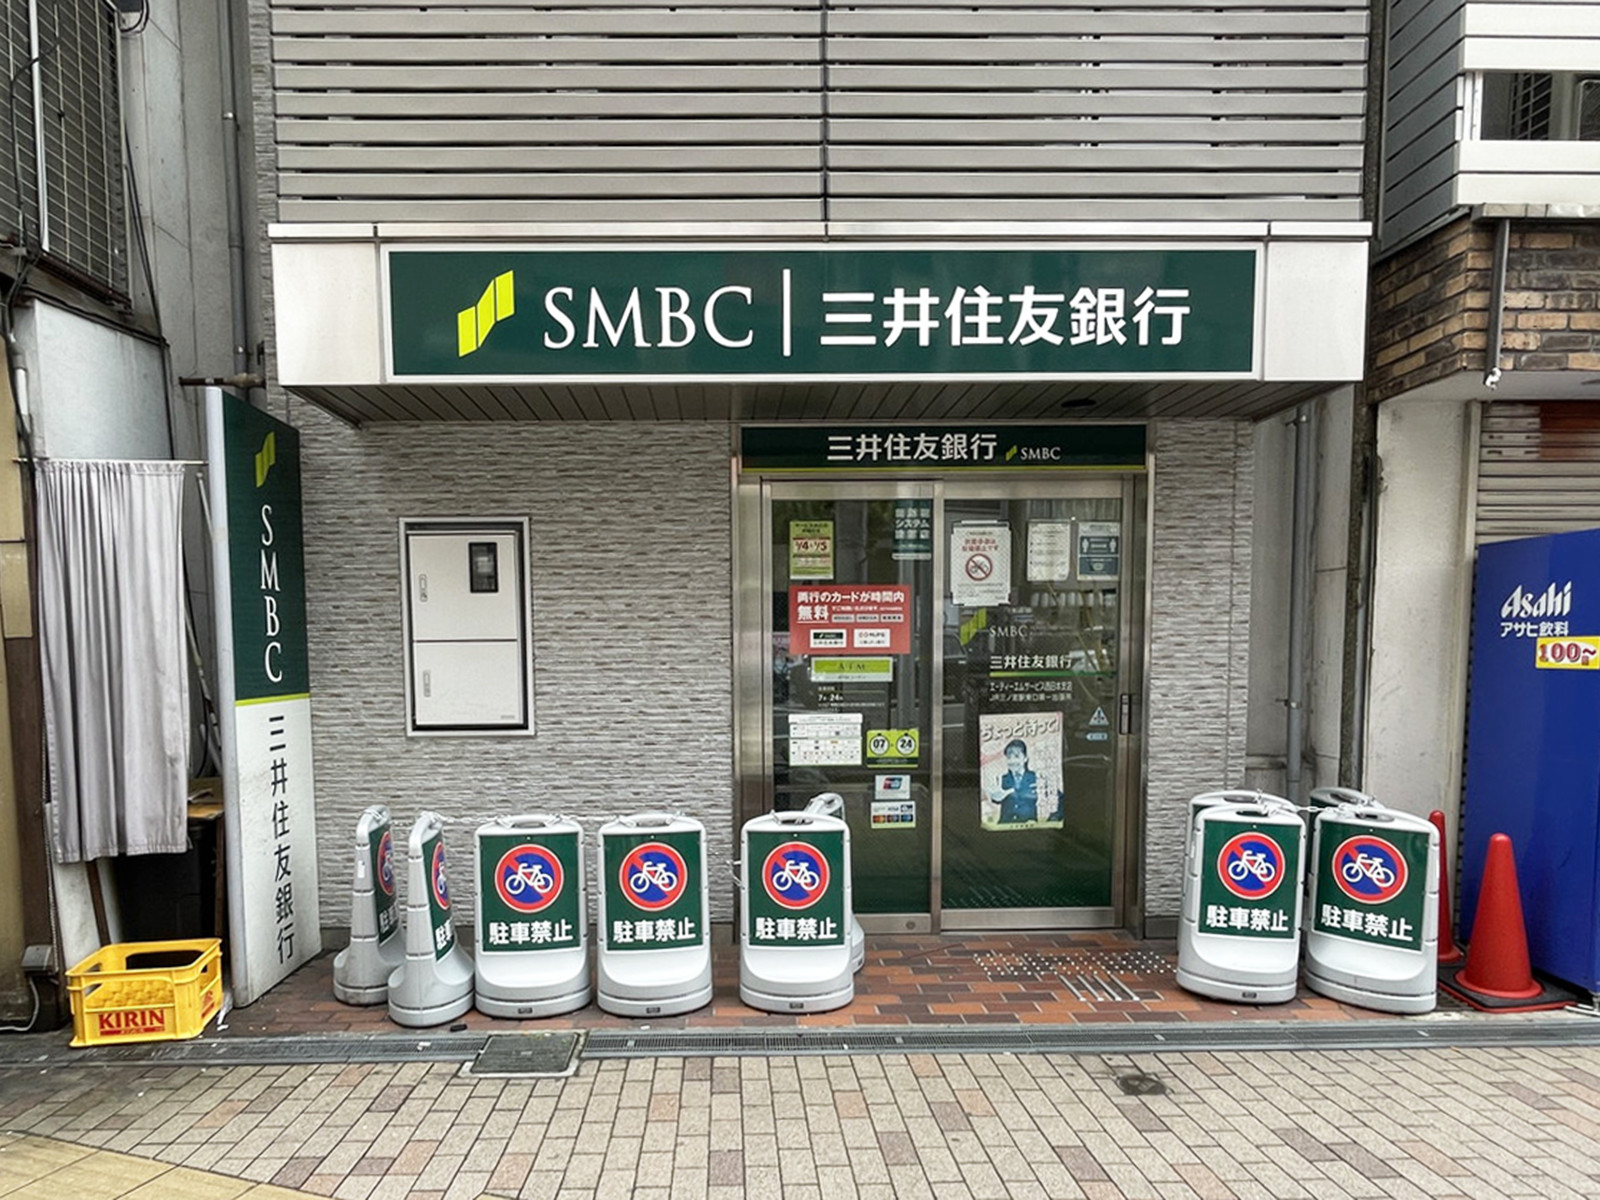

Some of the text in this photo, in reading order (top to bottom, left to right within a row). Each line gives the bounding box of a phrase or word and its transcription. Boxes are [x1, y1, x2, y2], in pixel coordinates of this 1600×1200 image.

[543, 285, 1191, 348] SMBC 三井住友銀行
[827, 433, 1062, 462] 三井住友銀行 SMBC
[260, 504, 283, 683] SMBC
[1501, 581, 1572, 618] Asahi
[797, 605, 829, 620] 無料
[989, 625, 1029, 637] SMBC
[1500, 621, 1569, 637] アサヒ飲料
[990, 655, 1073, 670] 三井住友銀行
[872, 738, 913, 749] 07 24
[269, 715, 295, 965] 三井住友銀行
[612, 917, 697, 943] 駐車禁止
[754, 917, 839, 941] 駐車禁止
[1206, 904, 1289, 932] 駐車禁止
[1321, 904, 1414, 942] 駐車禁止
[488, 919, 574, 945] 駐車禁止
[98, 1008, 165, 1030] KIRIN
